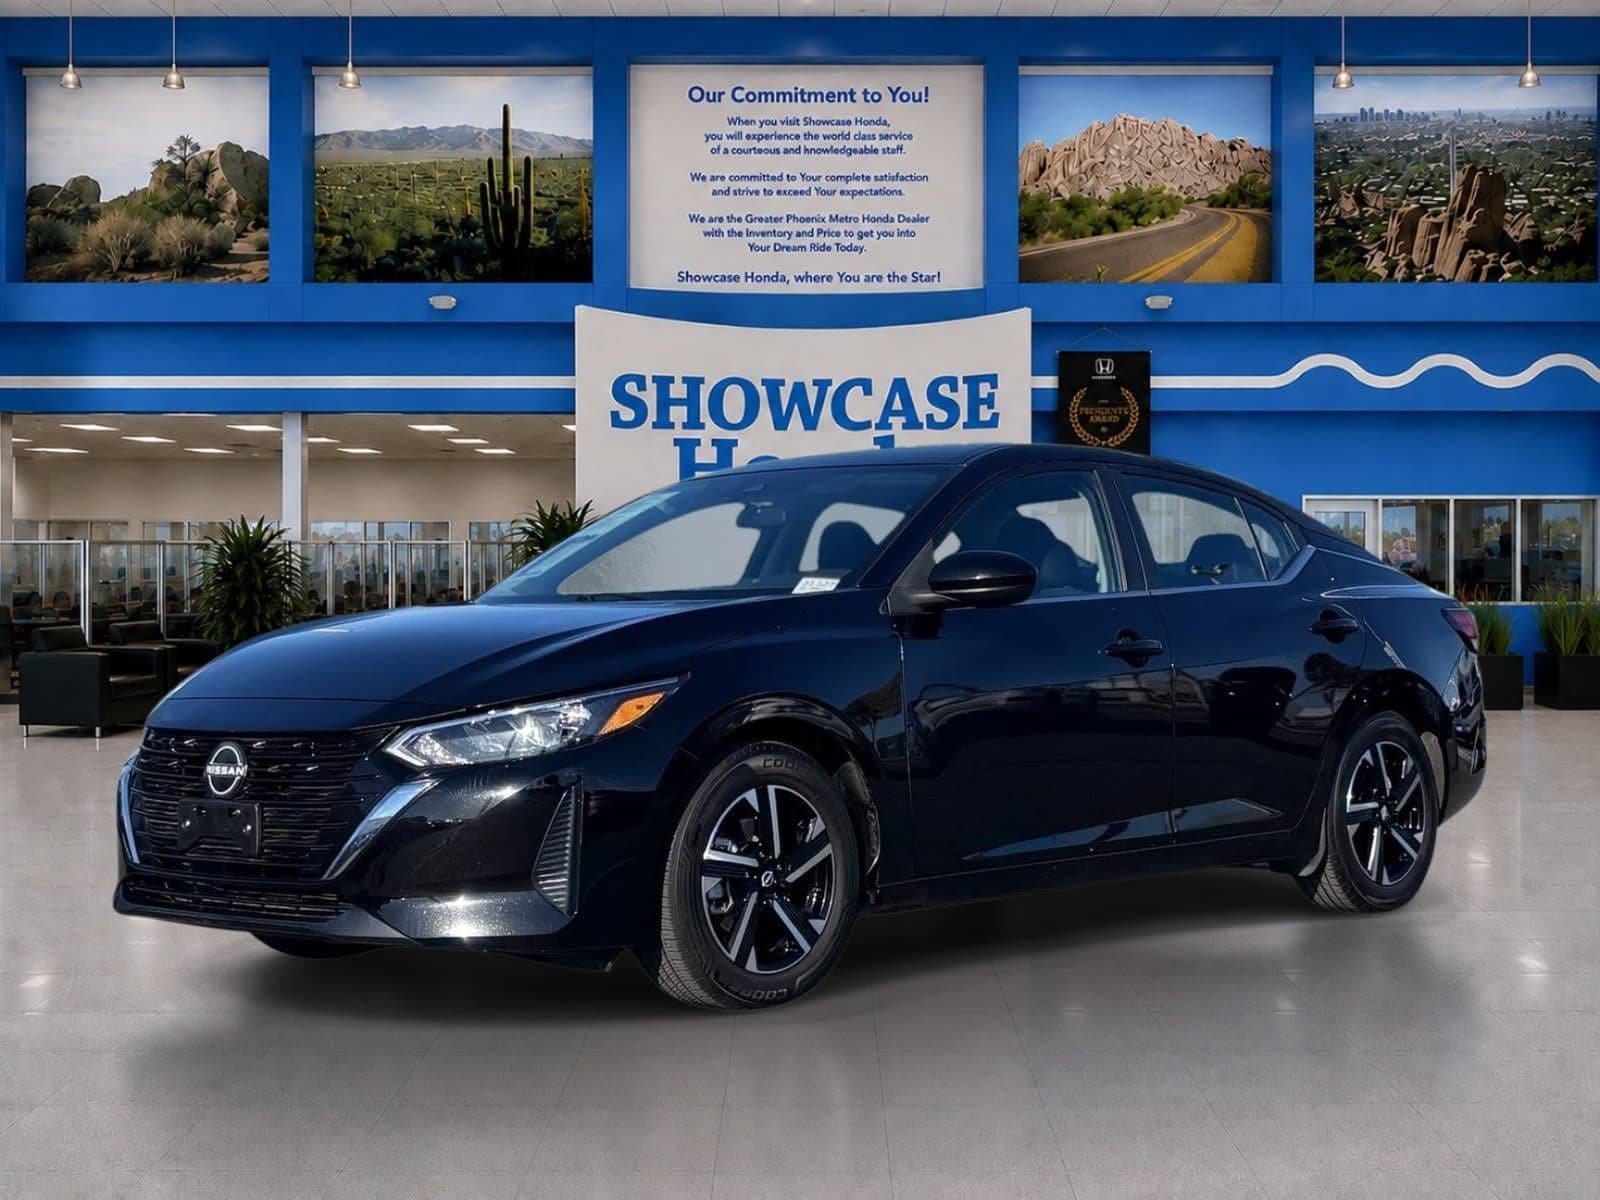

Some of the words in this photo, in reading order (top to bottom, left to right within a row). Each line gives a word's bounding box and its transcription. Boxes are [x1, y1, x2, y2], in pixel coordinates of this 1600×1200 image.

[688, 86, 727, 104] Our
[730, 86, 857, 104] Commitment
[861, 86, 883, 104] to
[887, 86, 930, 104] You!
[727, 116, 756, 126] When
[758, 119, 777, 128] you
[779, 116, 800, 126] visit
[802, 116, 852, 126] Showcase
[854, 116, 891, 129] Honda,
[704, 133, 723, 142] you
[725, 130, 743, 140] will
[745, 130, 802, 142] experience
[803, 130, 820, 140] the
[822, 130, 851, 140] world
[853, 130, 877, 140] class
[878, 130, 913, 140] service
[710, 144, 721, 155] of
[722, 147, 730, 155] a
[731, 144, 781, 155] courteous
[782, 144, 801, 155] and
[881, 144, 906, 155] staff.
[690, 171, 707, 182] We
[709, 174, 726, 182] are
[728, 171, 784, 182] committed
[786, 171, 797, 182] to
[798, 171, 823, 182] Your
[825, 171, 872, 184] complete
[873, 171, 929, 182] satisfaction
[711, 185, 731, 196] and
[732, 185, 761, 196] strive
[763, 185, 774, 196] to
[776, 185, 812, 196] exceed
[814, 185, 838, 196] Your
[839, 185, 906, 198] expectations.
[688, 213, 706, 223] We
[726, 213, 743, 223] the
[745, 213, 784, 223] Greater
[786, 213, 826, 223] Phoenix
[829, 213, 859, 223] Metro
[862, 213, 895, 223] Honda
[897, 213, 930, 223] Dealer
[702, 227, 725, 238] with
[727, 227, 744, 238] the
[745, 227, 793, 240] Inventory
[795, 227, 814, 238] and
[816, 227, 842, 238] Price
[843, 227, 855, 238] to
[856, 227, 874, 240] get
[876, 230, 895, 240] you
[896, 227, 917, 238] into
[747, 242, 772, 252] Your
[773, 242, 807, 252] Dream
[809, 242, 833, 252] Ride
[834, 242, 868, 254] Today.
[677, 270, 741, 283] Showcase
[744, 270, 791, 285] Honda,
[793, 270, 835, 283] where
[836, 270, 861, 283] You
[863, 274, 885, 283] are
[886, 270, 908, 283] the
[910, 270, 942, 283] Star!
[609, 372, 1001, 432] SHOWCASE
[206, 765, 245, 775] NISSAN
